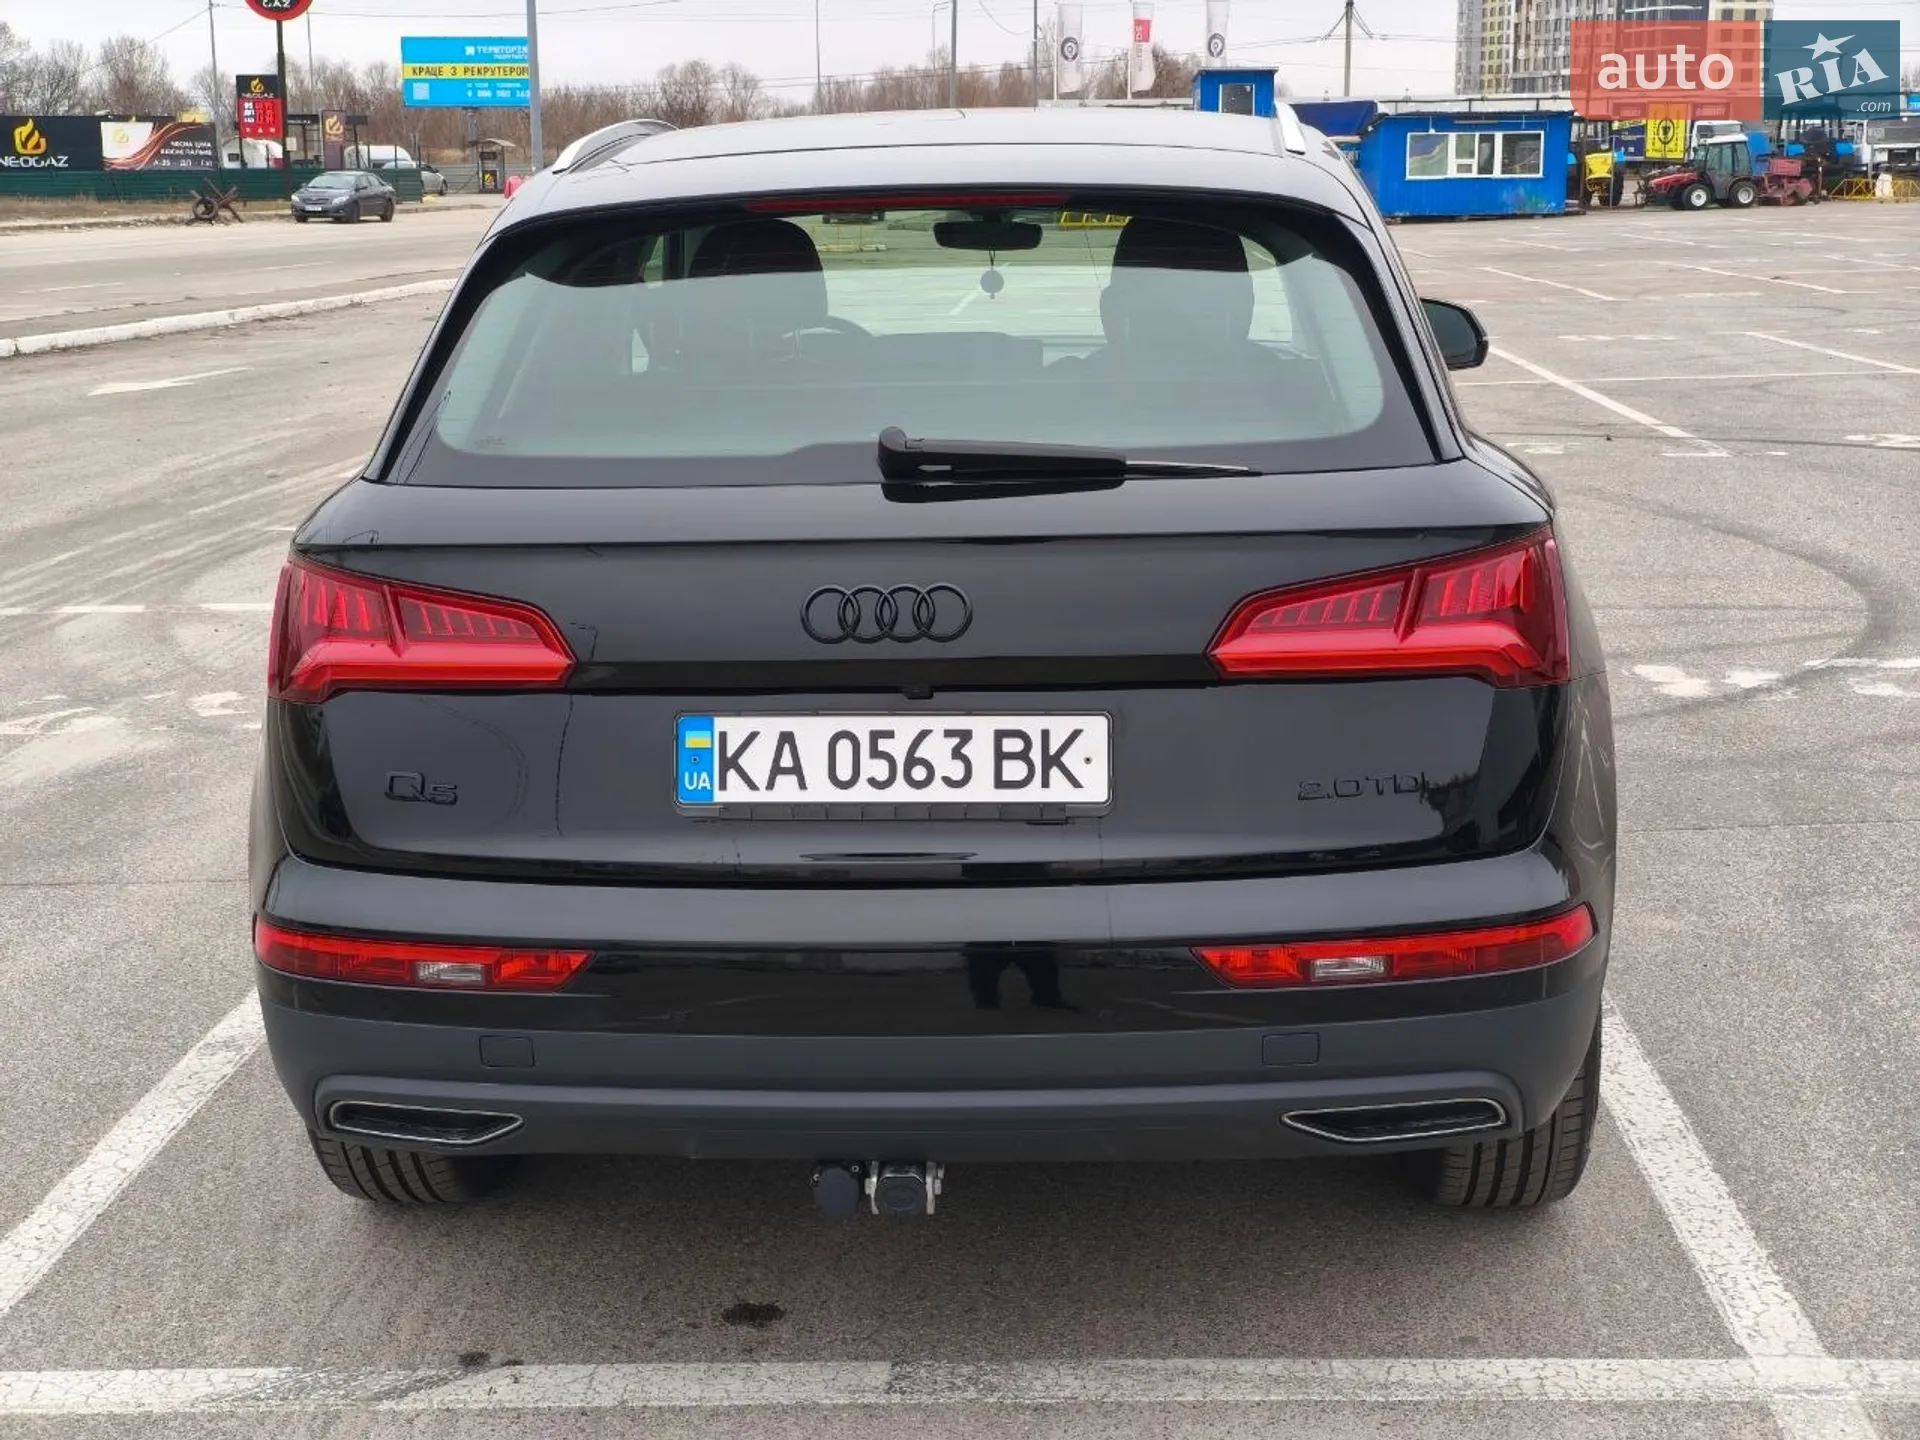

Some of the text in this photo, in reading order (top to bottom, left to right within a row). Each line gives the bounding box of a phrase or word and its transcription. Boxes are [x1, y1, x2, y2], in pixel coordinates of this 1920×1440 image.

[463, 66, 529, 76] РЕКРУТЕРОМ
[0, 156, 69, 168] NEOGAZ
[717, 728, 1085, 791] KA 0563 BK
[384, 770, 458, 806] Q5
[684, 772, 712, 791] UA
